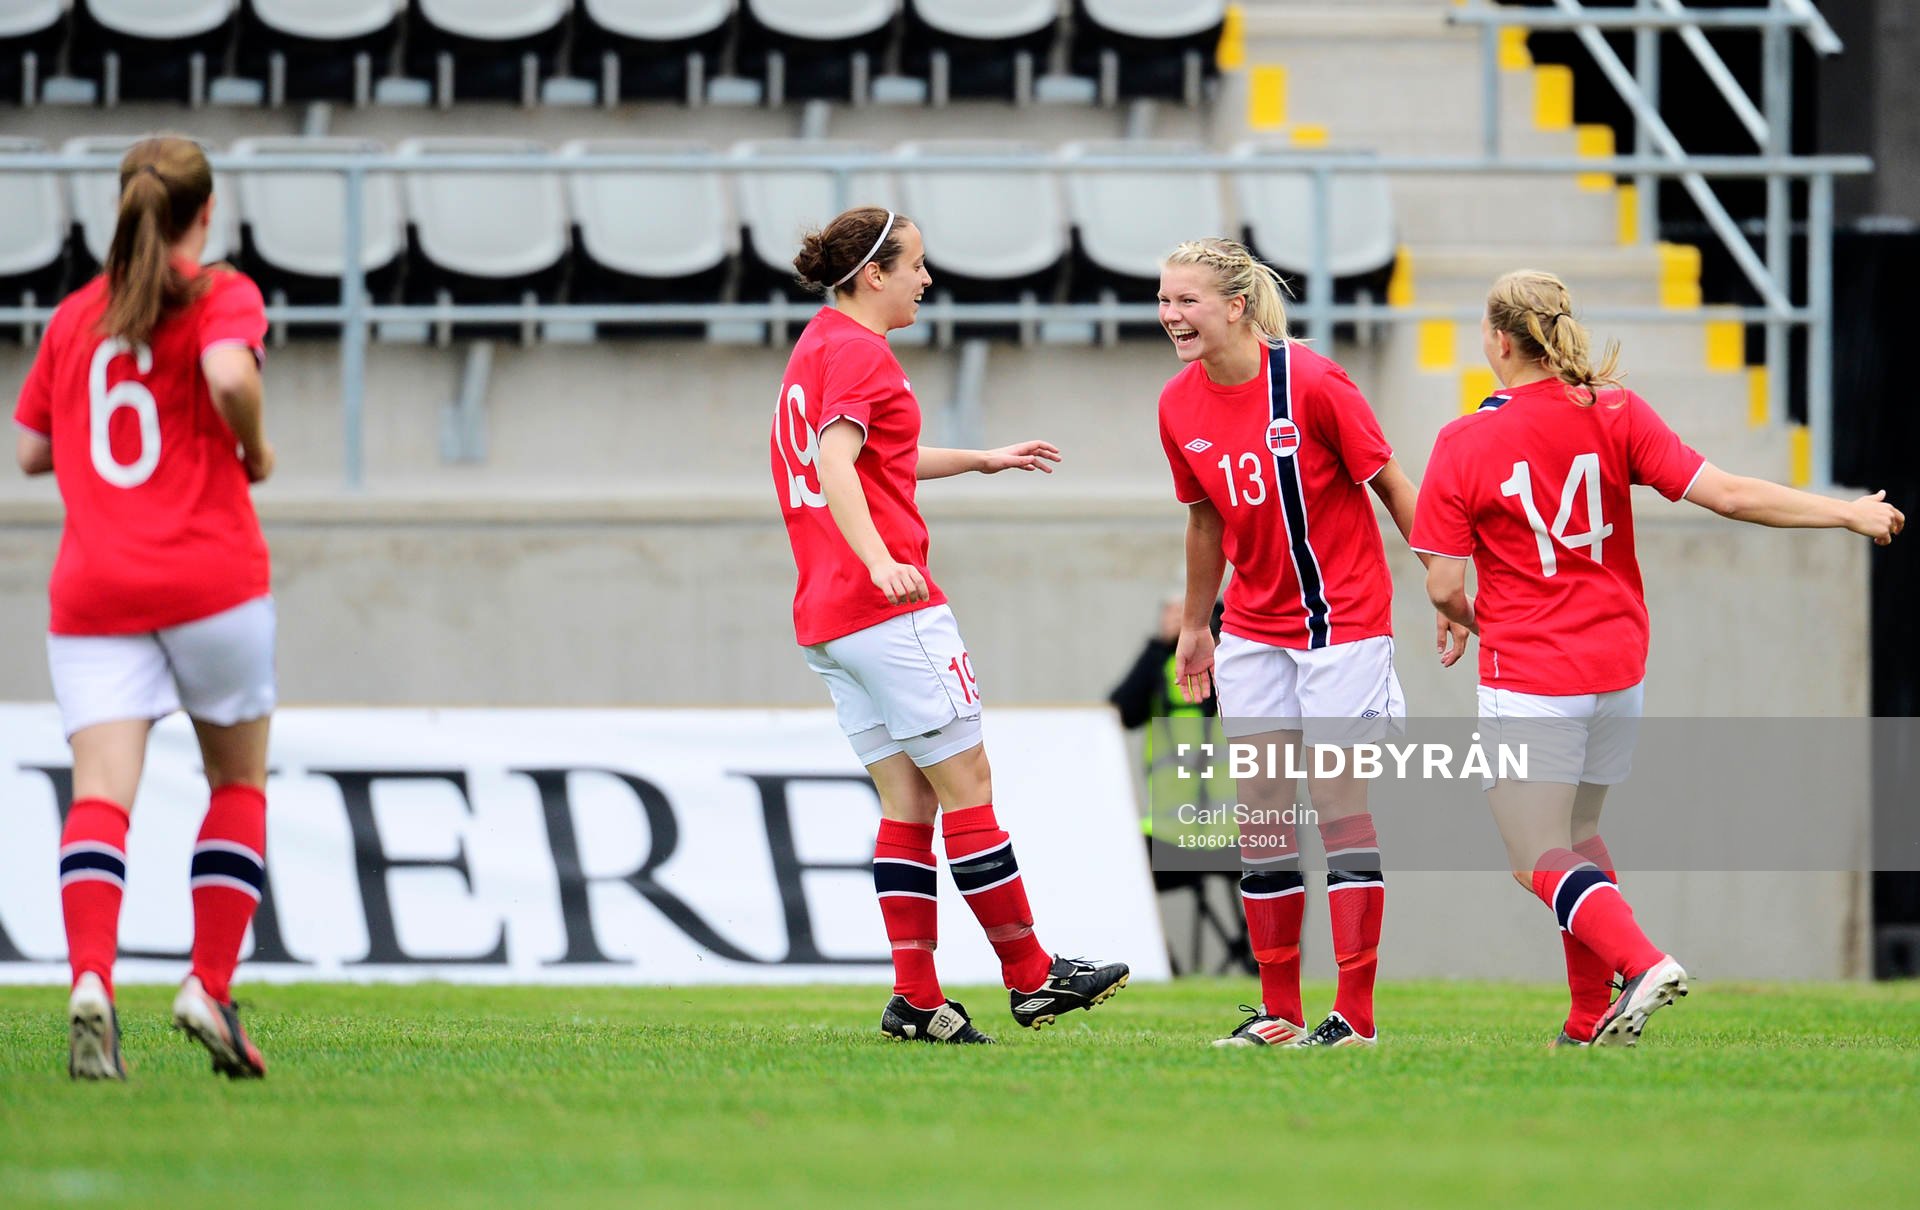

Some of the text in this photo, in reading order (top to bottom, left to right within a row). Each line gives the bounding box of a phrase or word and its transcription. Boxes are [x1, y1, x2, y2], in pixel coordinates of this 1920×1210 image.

[88, 335, 162, 489] 6
[775, 383, 828, 508] 19
[1217, 452, 1267, 507] 13
[1500, 452, 1614, 578] 14
[948, 652, 980, 704] 19
